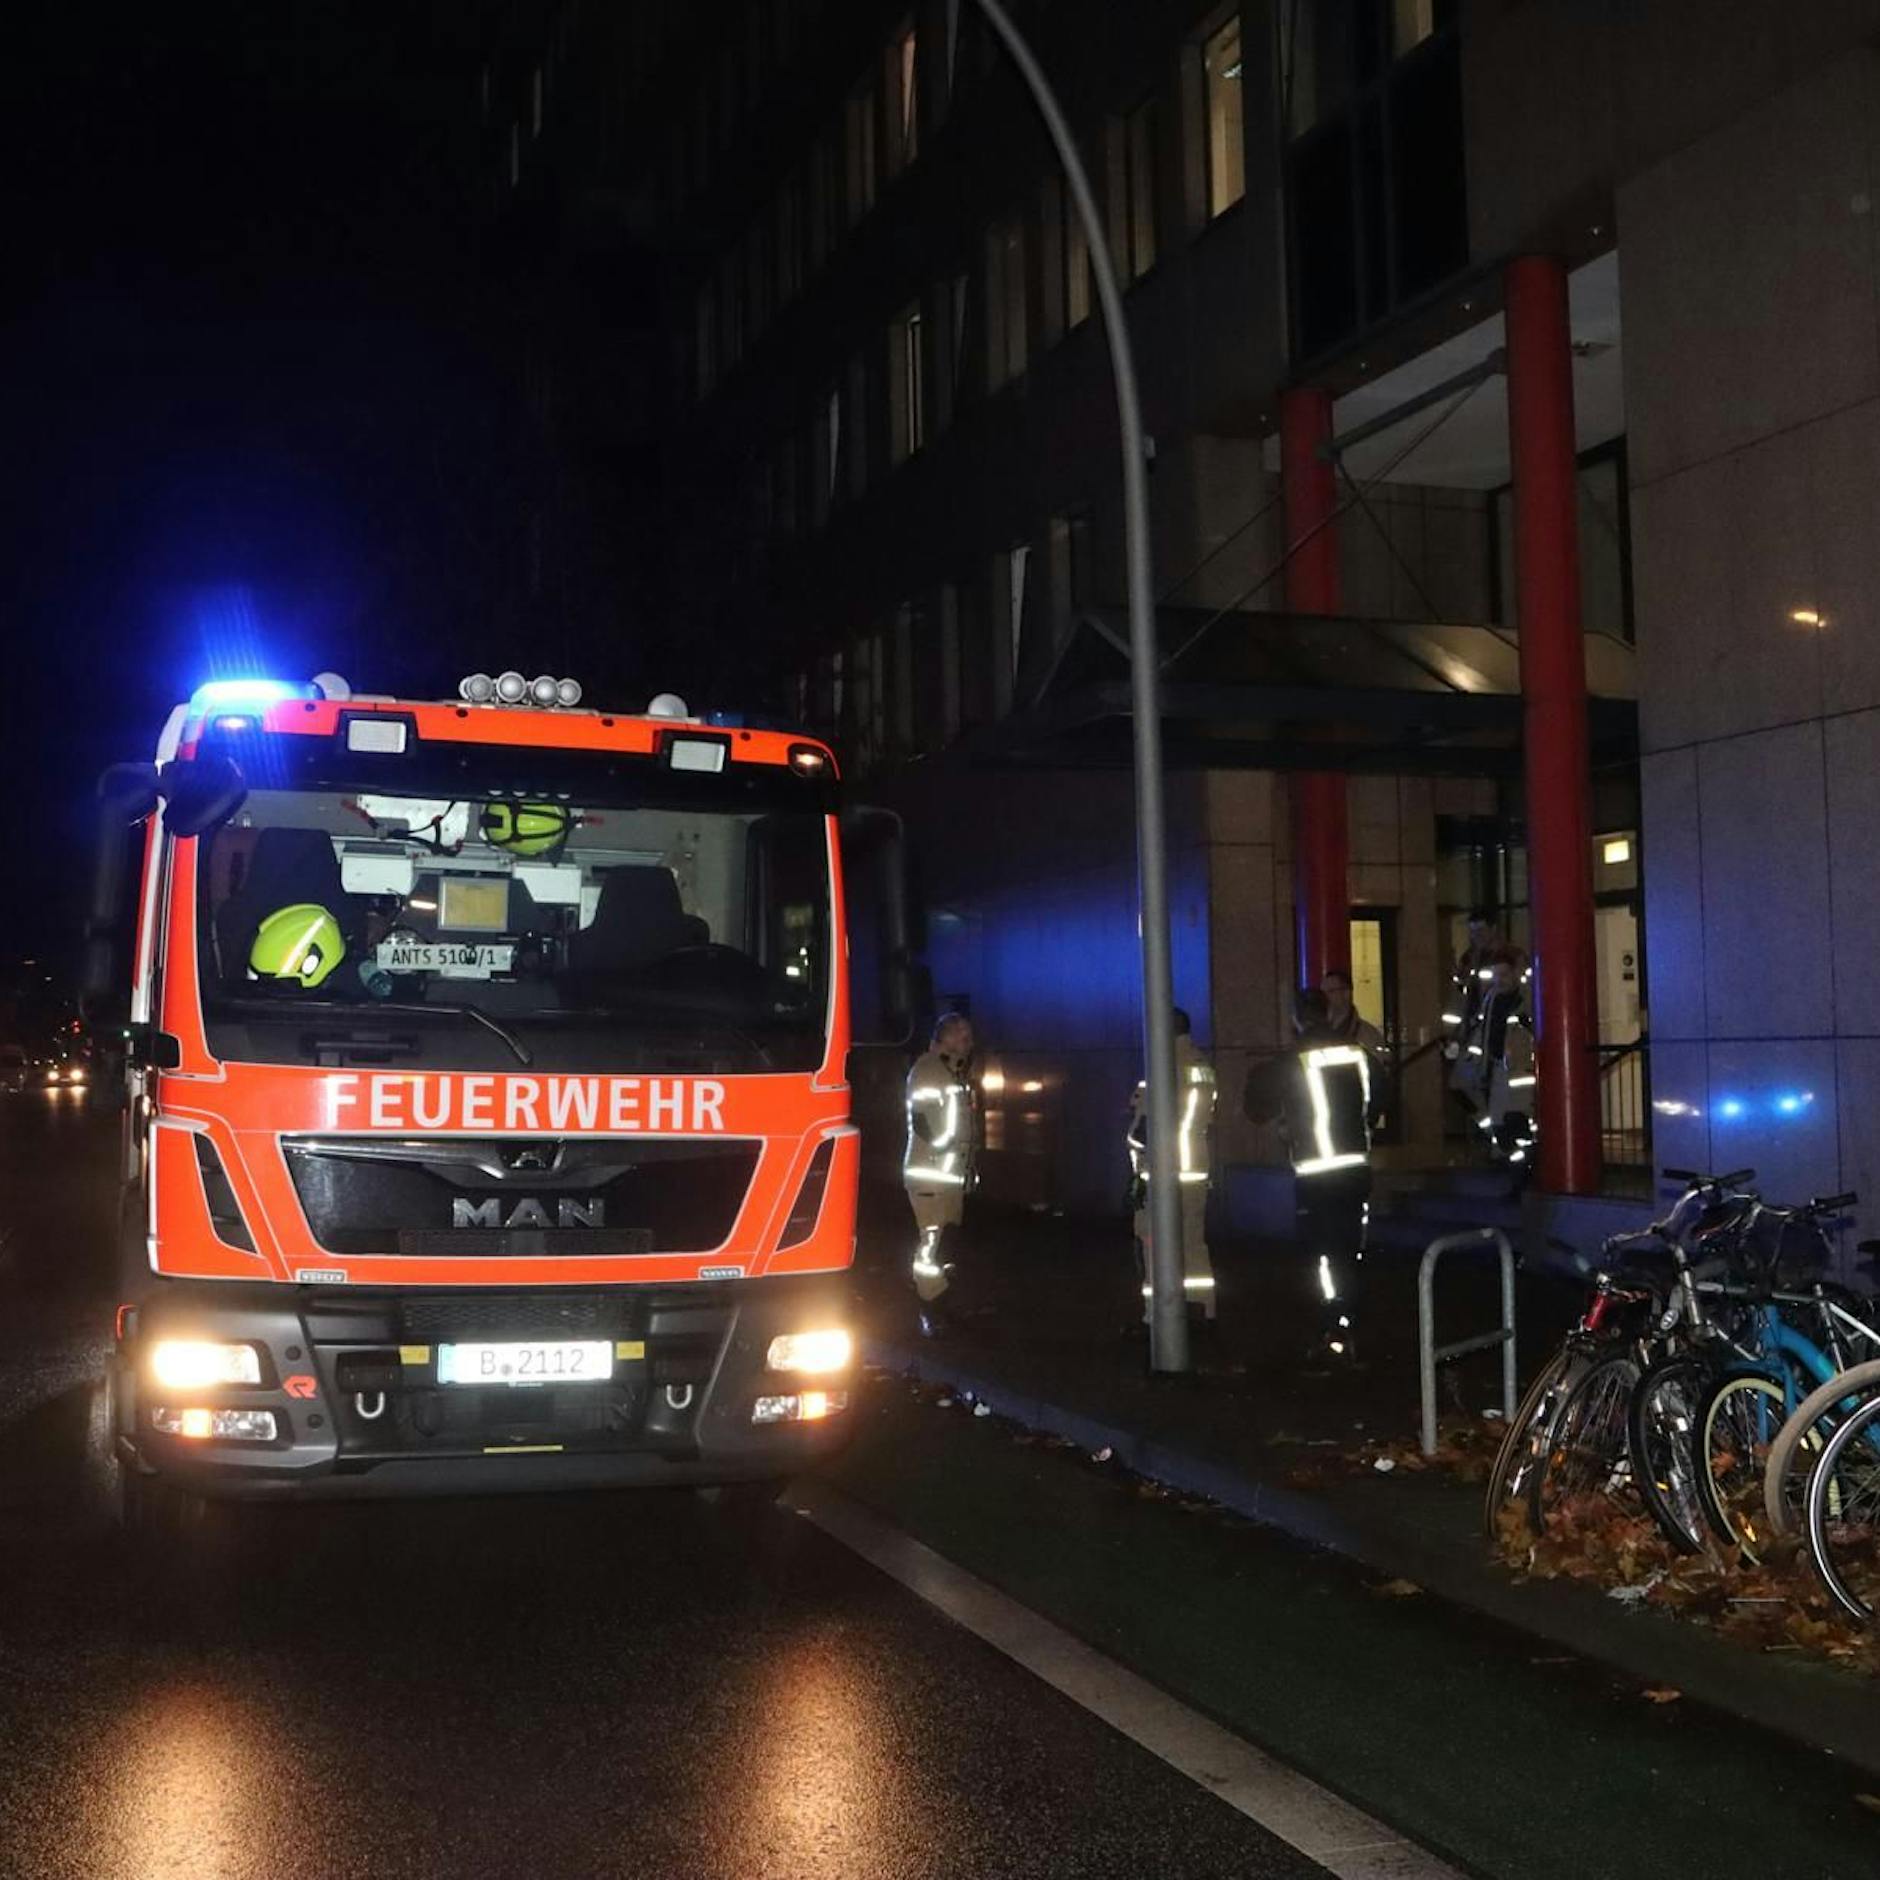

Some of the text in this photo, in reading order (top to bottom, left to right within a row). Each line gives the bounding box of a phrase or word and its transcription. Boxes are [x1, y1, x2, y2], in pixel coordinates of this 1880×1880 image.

[391, 948, 431, 965] ANTS
[324, 1075, 726, 1130] FEUERWEHR
[453, 1197, 606, 1228] MAN
[480, 1348, 585, 1375] B 2112
